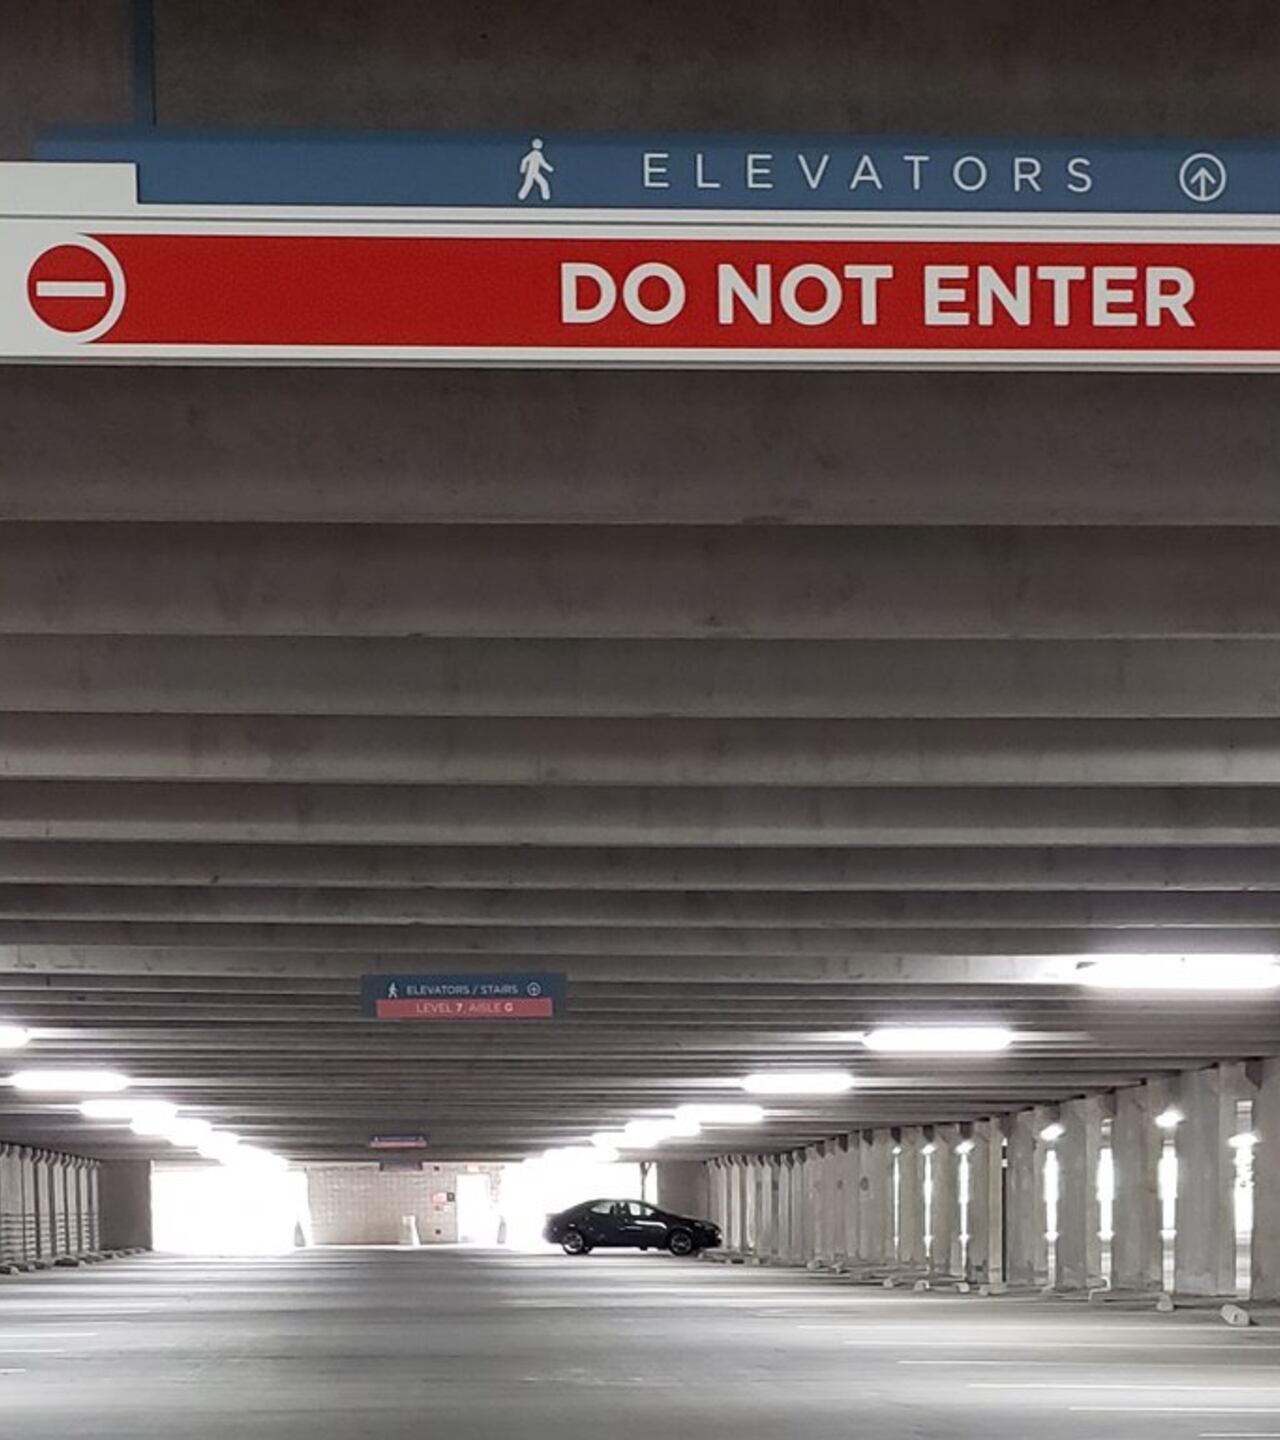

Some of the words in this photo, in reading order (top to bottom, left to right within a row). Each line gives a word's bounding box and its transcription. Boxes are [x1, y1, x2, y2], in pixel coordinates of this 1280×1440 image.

[642, 153, 1095, 193] ELEVATORS
[561, 262, 686, 325] DO
[719, 264, 894, 326] NOT
[924, 266, 1195, 328] ENTER
[407, 984, 470, 995] ELEVATORS
[480, 984, 519, 995] STAIRS
[416, 1003, 452, 1013] LEVEL
